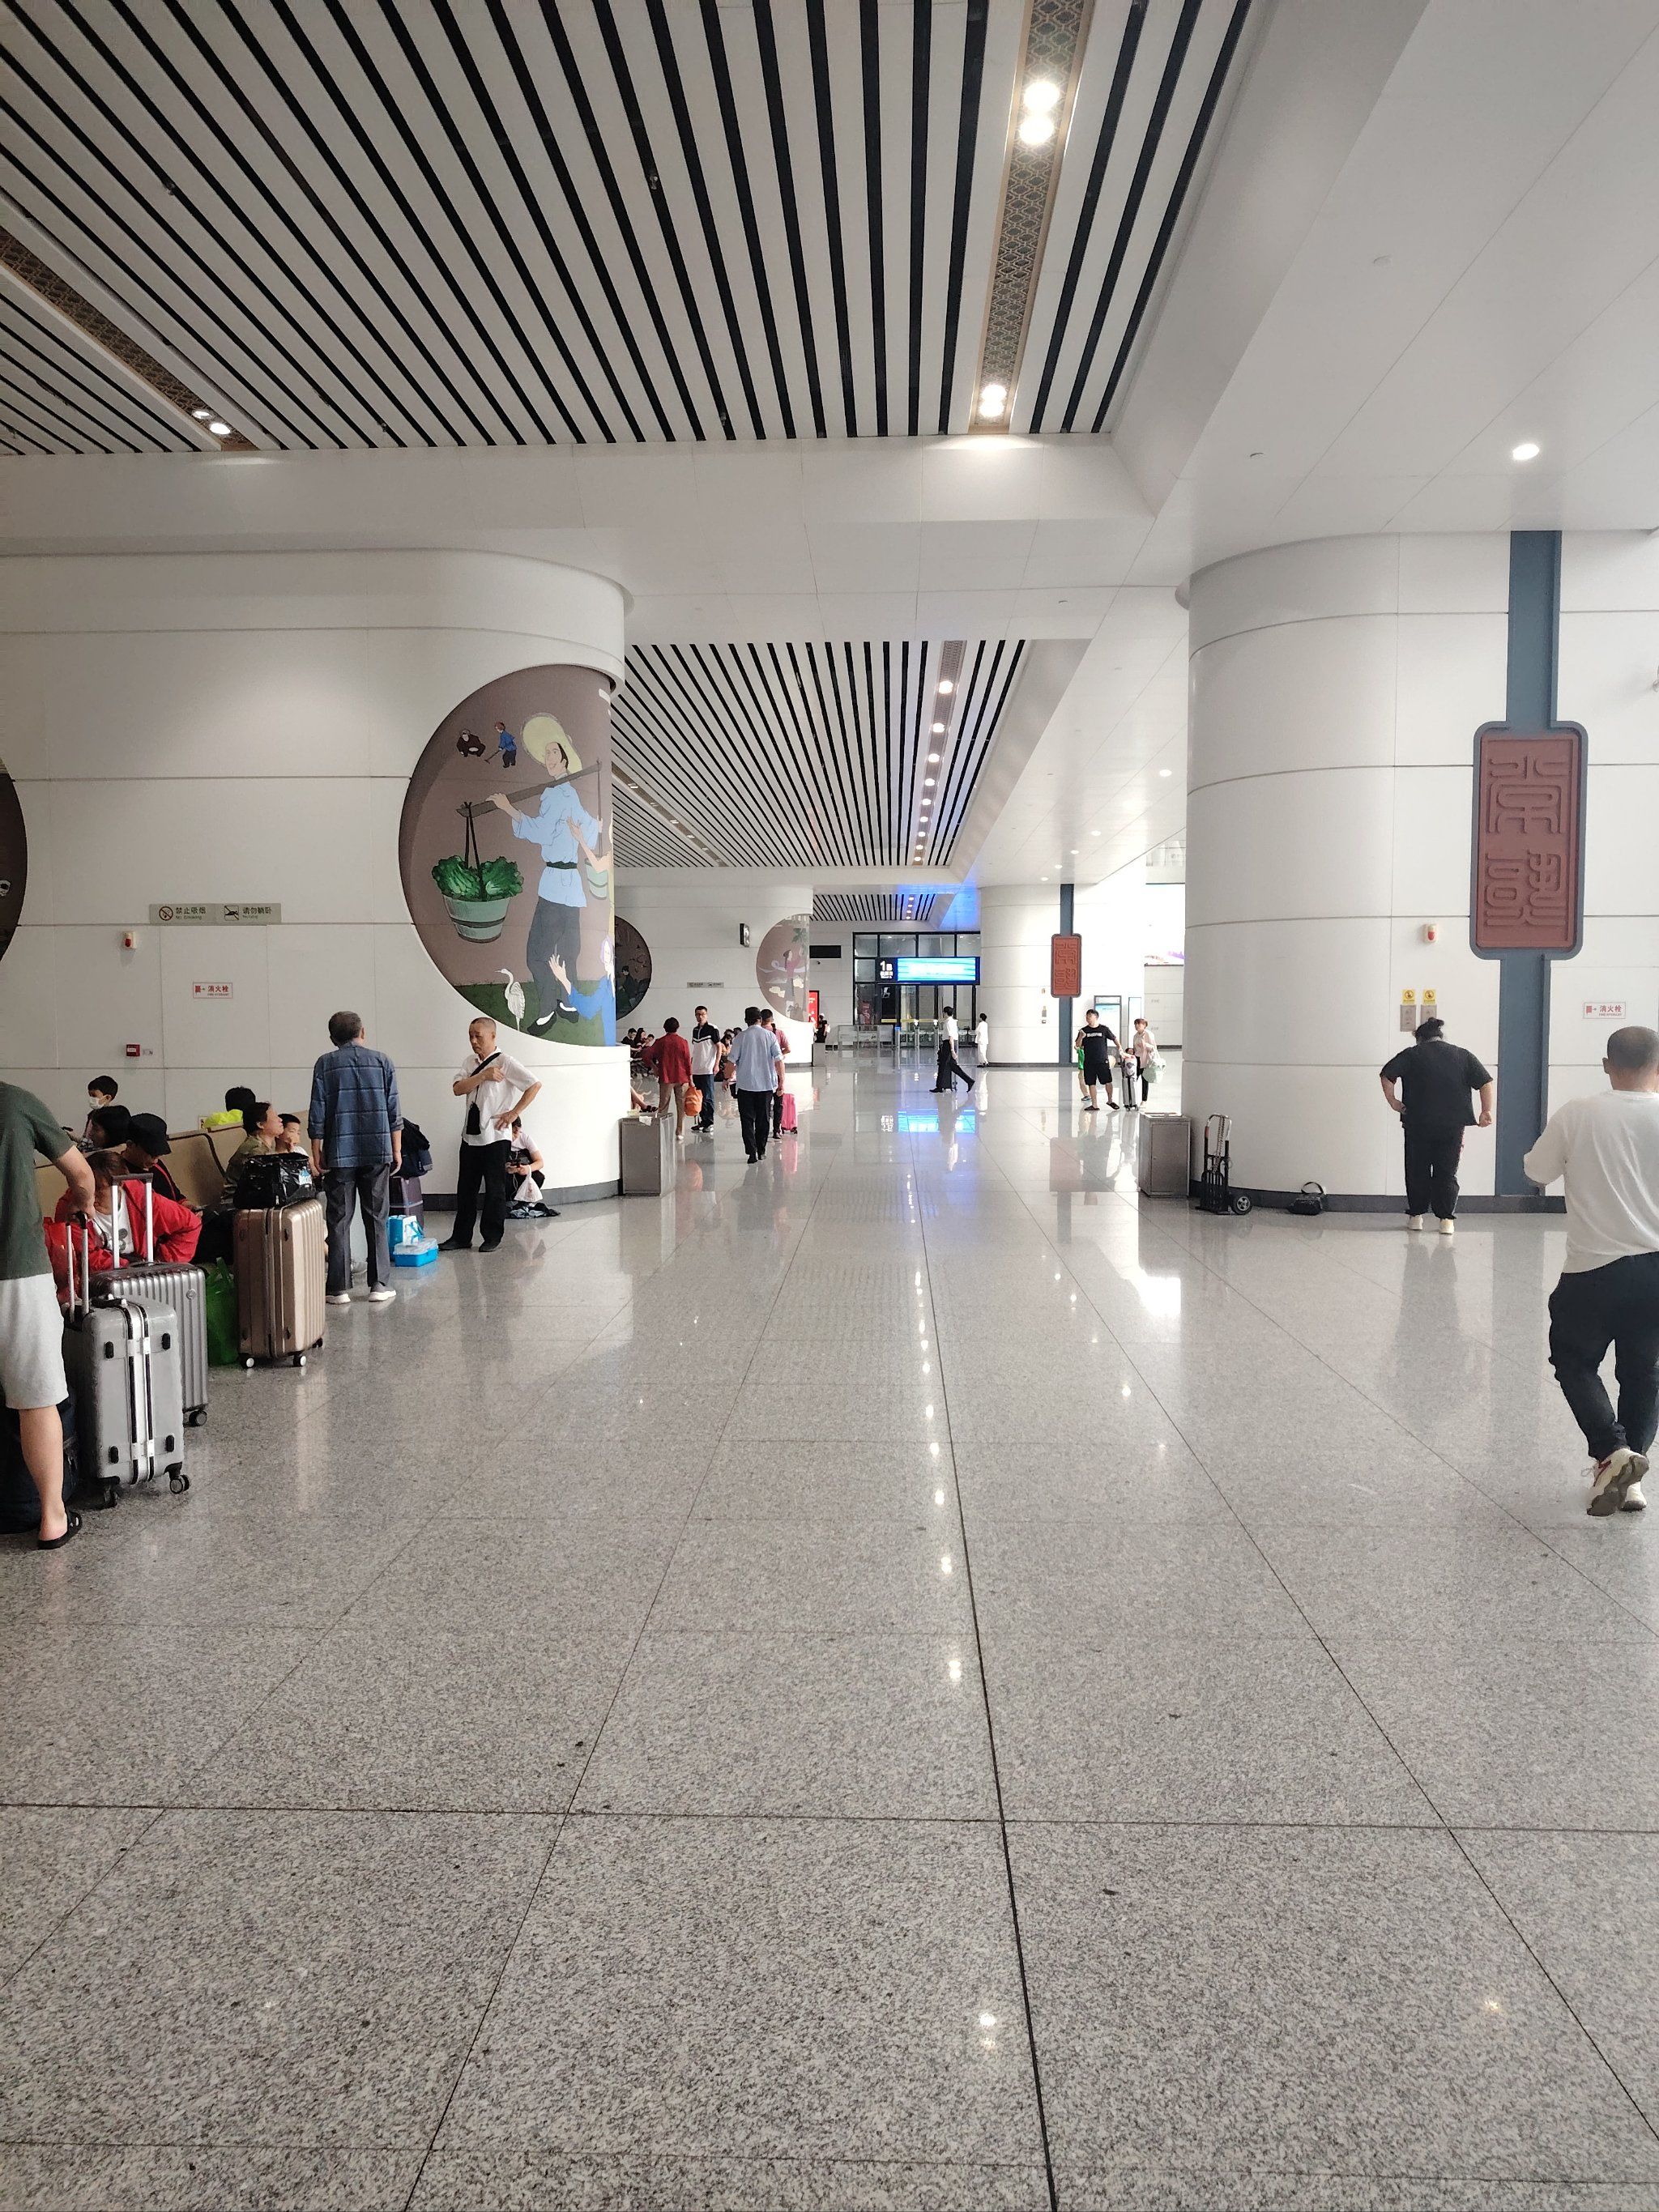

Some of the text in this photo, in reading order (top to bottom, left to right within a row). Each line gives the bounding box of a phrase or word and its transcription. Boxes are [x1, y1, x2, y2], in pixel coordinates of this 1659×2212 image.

[175, 906, 207, 914] 禁止吸烟
[242, 906, 272, 914] 请勿躺卧
[207, 985, 229, 993] 消火栓
[1599, 1004, 1622, 1012] 消火栓
